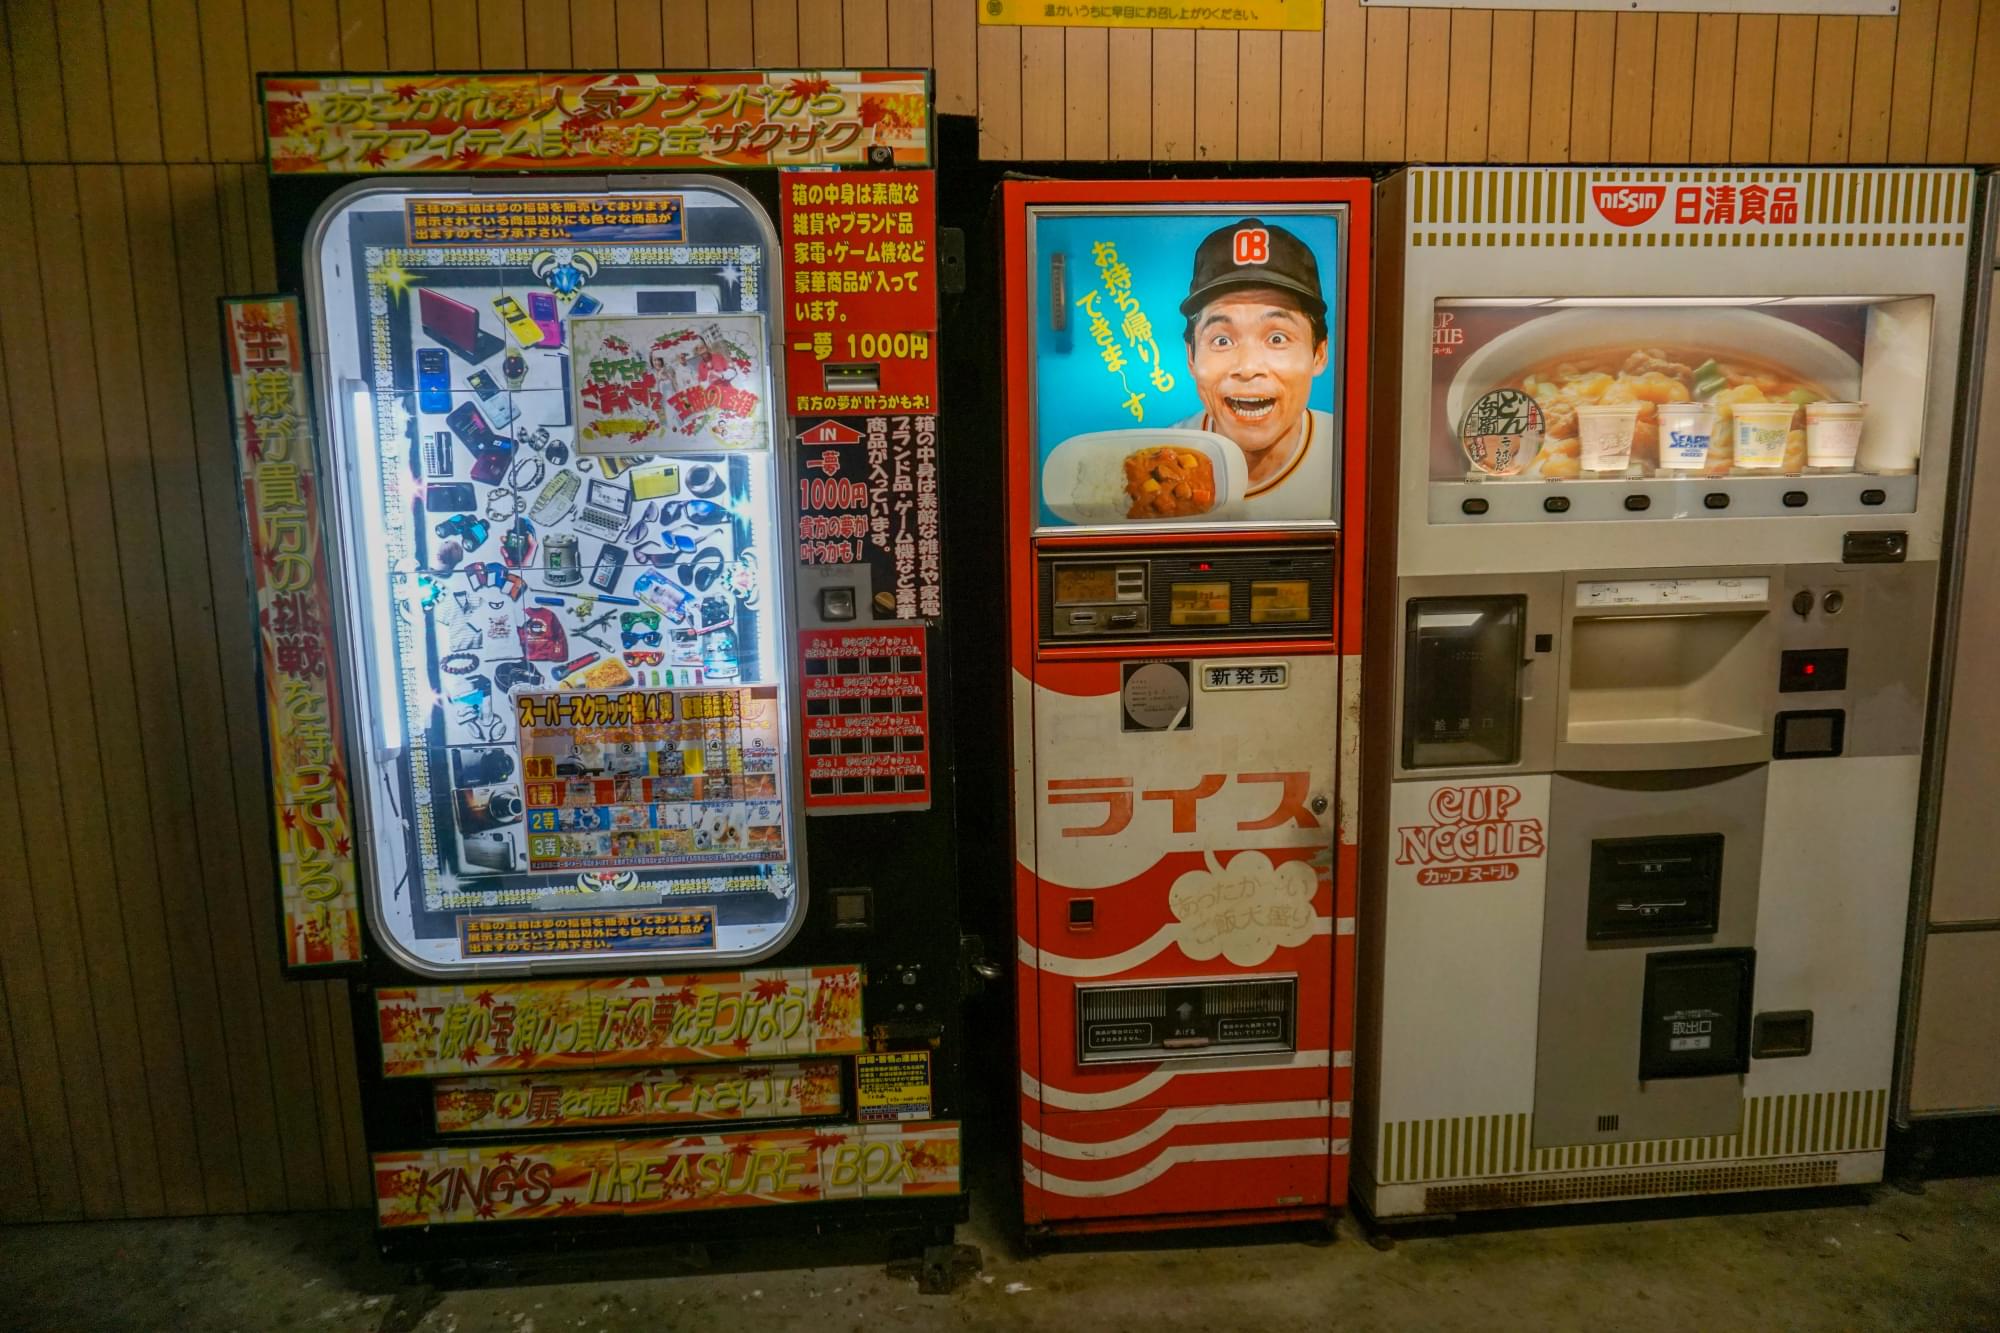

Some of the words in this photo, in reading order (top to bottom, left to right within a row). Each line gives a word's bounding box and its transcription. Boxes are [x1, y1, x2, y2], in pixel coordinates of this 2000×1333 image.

[792, 183, 919, 206] 箱の中身は素敵な
[1675, 185, 1799, 225] 日清食品
[793, 211, 913, 235] 雑貨やブランド品
[794, 240, 926, 264] 家電・ゲーム機など
[795, 270, 919, 294] 豪華商品が入って
[795, 300, 847, 322] います。
[1092, 241, 1175, 393] お持ち帰りも
[794, 332, 833, 361] 一夢
[848, 333, 929, 360] 1000円
[819, 427, 838, 442] IN
[806, 450, 841, 477] 一夢
[801, 477, 869, 511] 1000円
[866, 417, 890, 553] 商品が入っています。
[800, 514, 869, 540] 貴方の夢が
[1211, 667, 1280, 686] 新発売
[1048, 772, 1320, 837] ライス
[1429, 785, 1521, 826] CUP
[1396, 819, 1546, 864] NOODLE
[1423, 866, 1514, 884] カップヌードル
[1672, 1020, 1712, 1035] 取出口
[415, 1157, 556, 1212] KING'S
[587, 1149, 810, 1204] TREASURE
[830, 1140, 924, 1187] BOX
